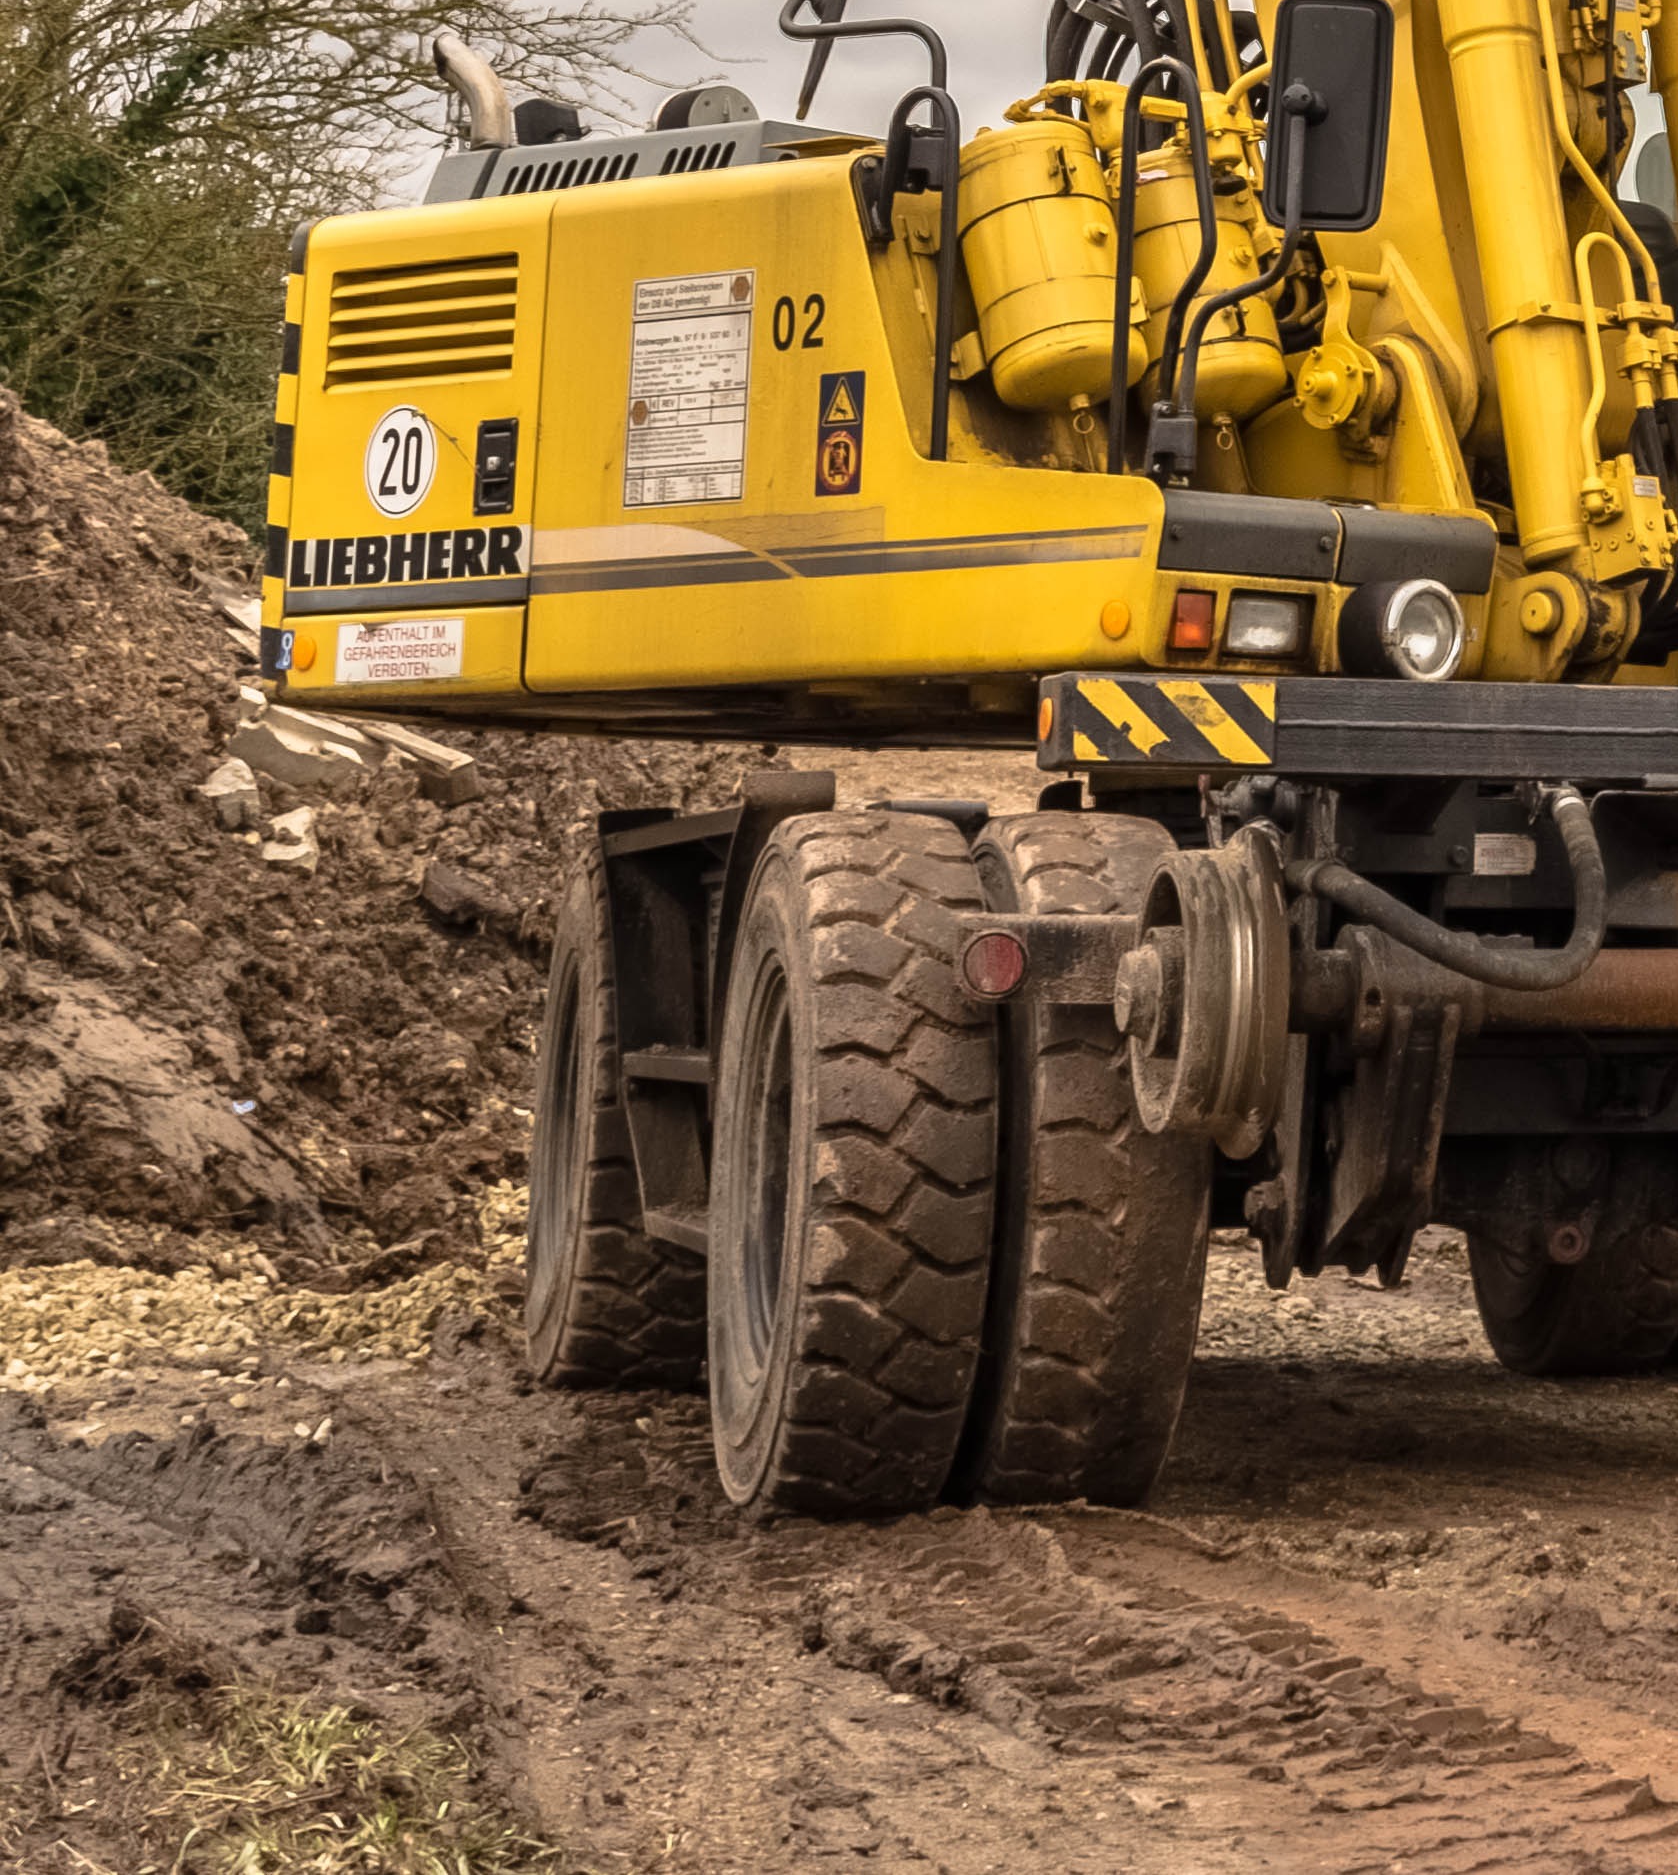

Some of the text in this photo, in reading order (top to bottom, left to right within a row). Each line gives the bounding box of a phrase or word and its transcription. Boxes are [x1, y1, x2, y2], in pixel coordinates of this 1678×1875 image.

[772, 293, 826, 352] 02
[378, 426, 424, 497] 20
[289, 525, 523, 587] LIEBHERR
[343, 642, 457, 662] GEFAHRENBEREICH
[355, 624, 446, 643] AUFENTHALT IM
[367, 661, 431, 678] VERBOTEN
